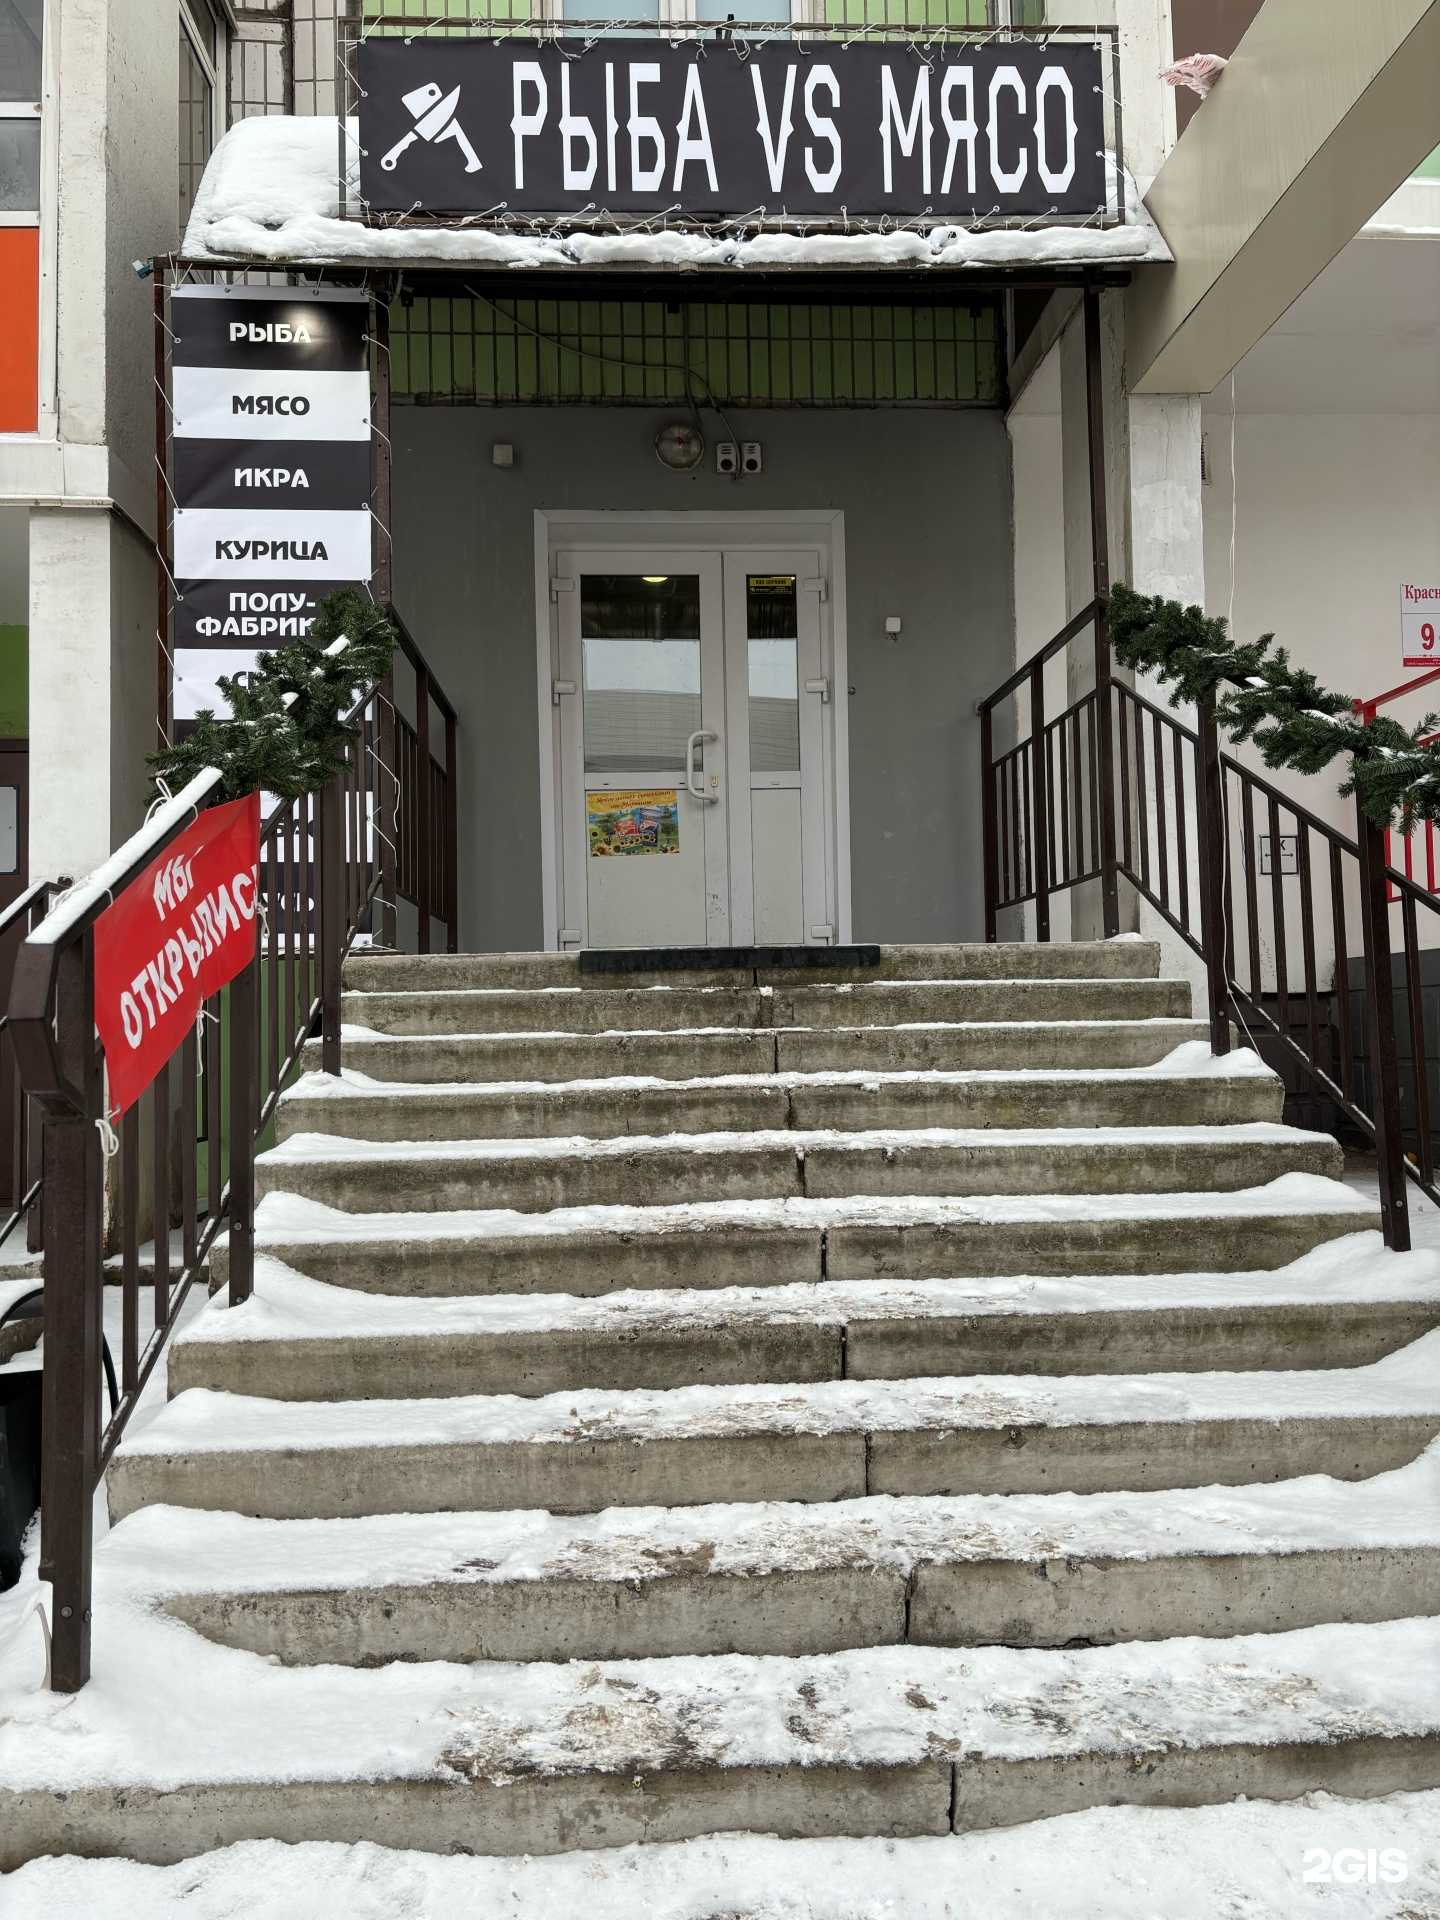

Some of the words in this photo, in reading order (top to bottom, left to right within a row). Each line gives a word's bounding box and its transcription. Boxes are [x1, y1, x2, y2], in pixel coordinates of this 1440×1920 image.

[510, 61, 720, 193] РЫБА
[749, 63, 843, 194] VS
[880, 64, 1079, 196] МЯСО
[229, 322, 312, 343] РЫБА
[232, 395, 311, 416] МЯСО
[233, 467, 310, 488] ИКРА
[215, 540, 329, 561] КУРИЦА
[229, 592, 316, 613] ПОЛУ-
[195, 616, 317, 637] ФАБРИК
[1421, 623, 1435, 651] 9
[153, 847, 203, 922] МЫ
